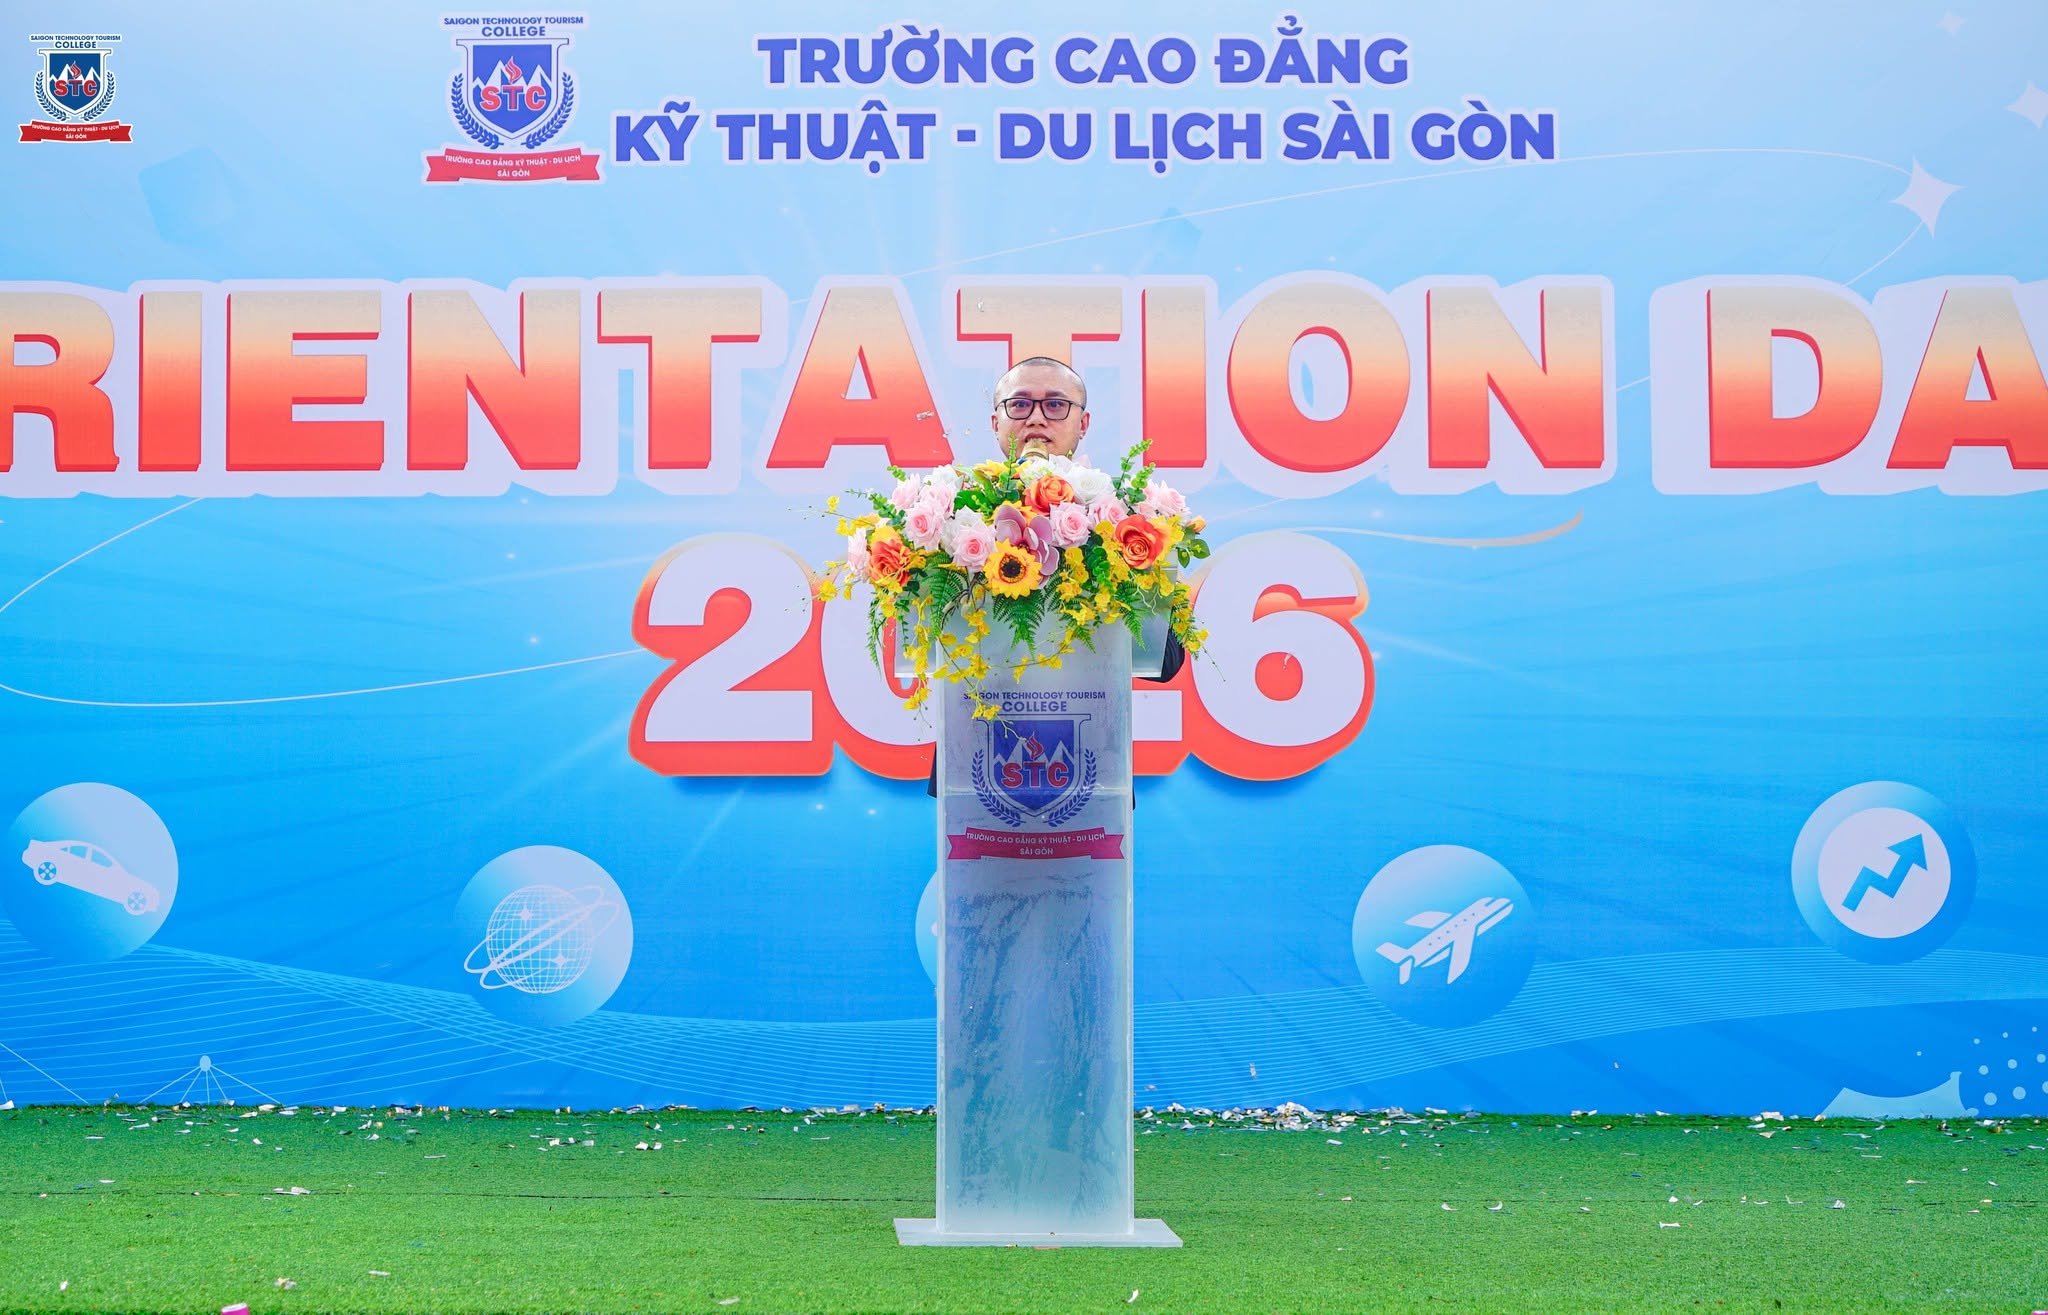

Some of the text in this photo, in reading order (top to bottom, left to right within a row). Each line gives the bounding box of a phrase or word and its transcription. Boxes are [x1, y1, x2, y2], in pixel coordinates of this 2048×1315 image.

[482, 17, 542, 25] TECHNOLOGY
[545, 17, 584, 25] TOURISM
[481, 26, 546, 37] COLLEGE
[757, 15, 1408, 84] TRƯỜNG CAO ĐẲNG
[481, 86, 546, 110] STC
[615, 101, 700, 162] KỸ
[716, 99, 937, 174] THUẬT
[1000, 112, 1093, 160] DU
[1115, 112, 1262, 174] LỊCH
[1283, 100, 1391, 161] SÀI
[1411, 100, 1556, 161] GÒN
[445, 154, 473, 165] TRƯỜNG
[564, 154, 581, 163] LỊCH
[497, 169, 530, 177] SÀI GÒN
[1002, 691, 1064, 700] TECHNOLOGY
[1066, 691, 1106, 700] TOURISM
[1002, 701, 1068, 712] COLLEGE
[1002, 762, 1068, 787] STC
[966, 832, 995, 843] TRƯỜNG
[997, 836, 1014, 844] CAO
[1077, 834, 1087, 842] DU
[1088, 833, 1105, 842] LỊCH
[1020, 847, 1053, 856] SÀI GÒN
